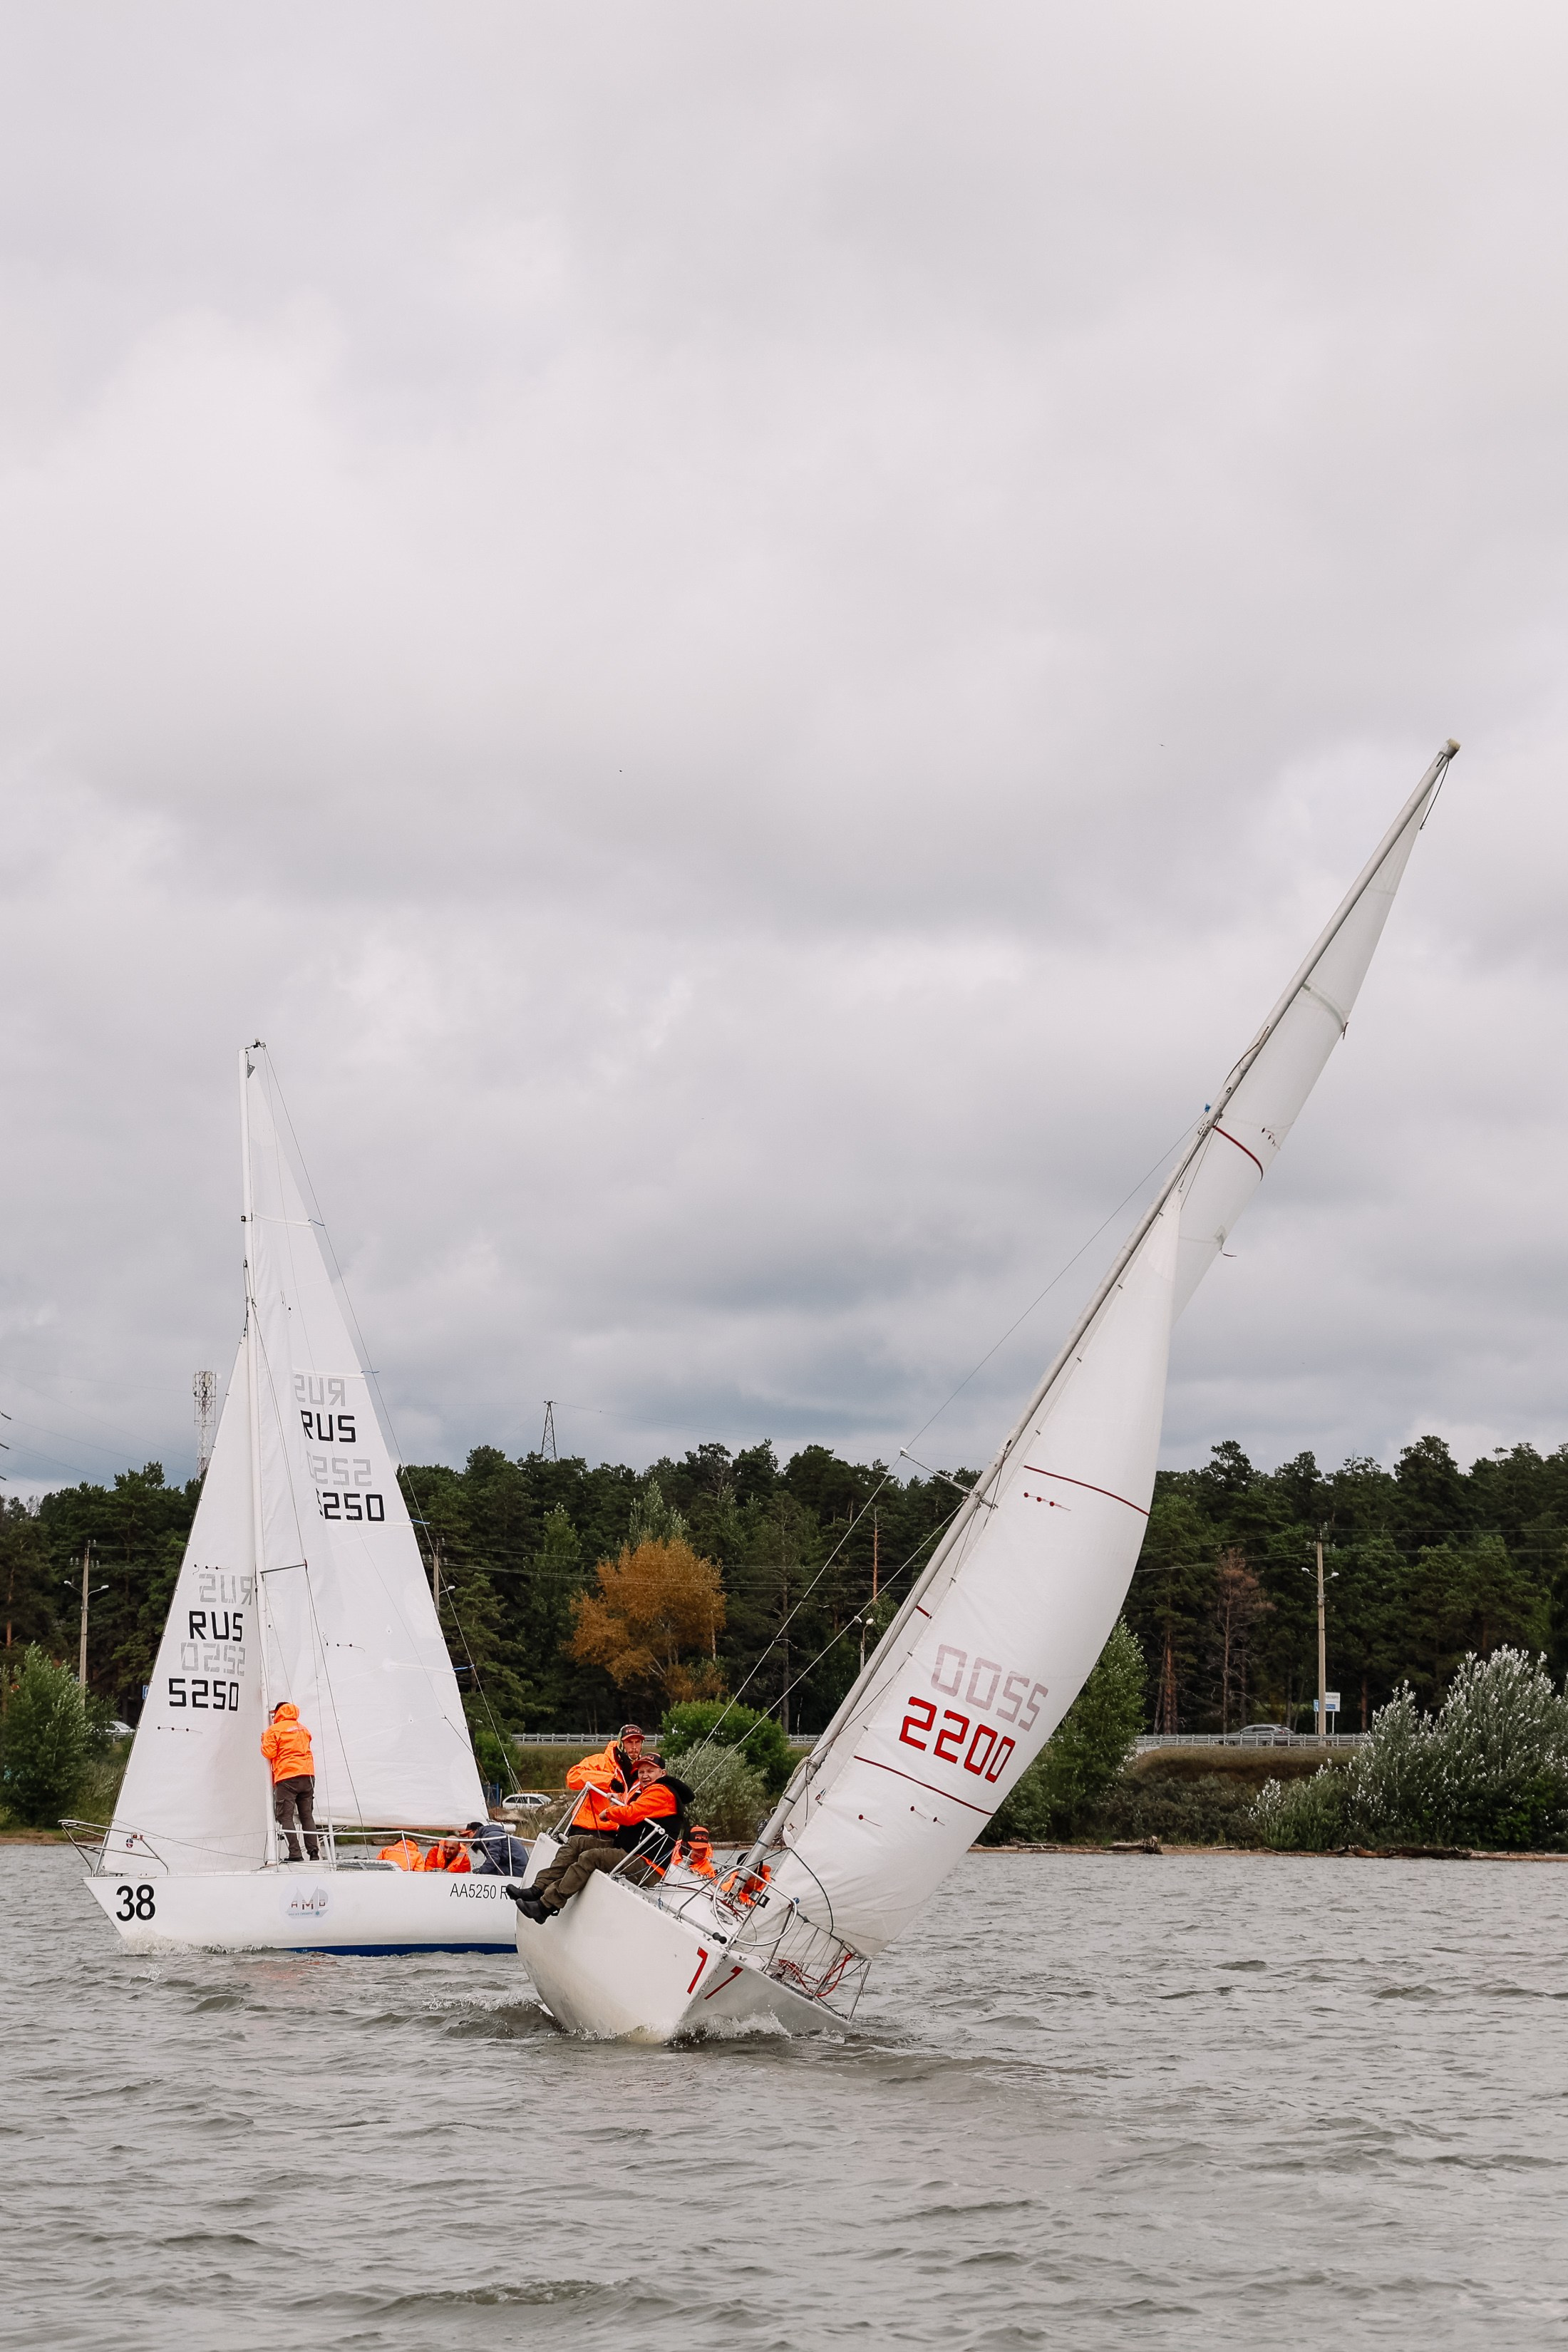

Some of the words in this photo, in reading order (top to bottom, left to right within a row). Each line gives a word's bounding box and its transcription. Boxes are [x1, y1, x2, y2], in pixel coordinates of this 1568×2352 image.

[300, 1410, 356, 1443] RUS
[189, 1611, 243, 1642] RUS
[168, 1678, 239, 1711] 5250
[899, 1696, 1016, 1784] 2200
[115, 1884, 156, 1922] 38
[450, 1883, 497, 1899] AA5250
[500, 1885, 508, 1899] R
[686, 1946, 708, 1995] 7
